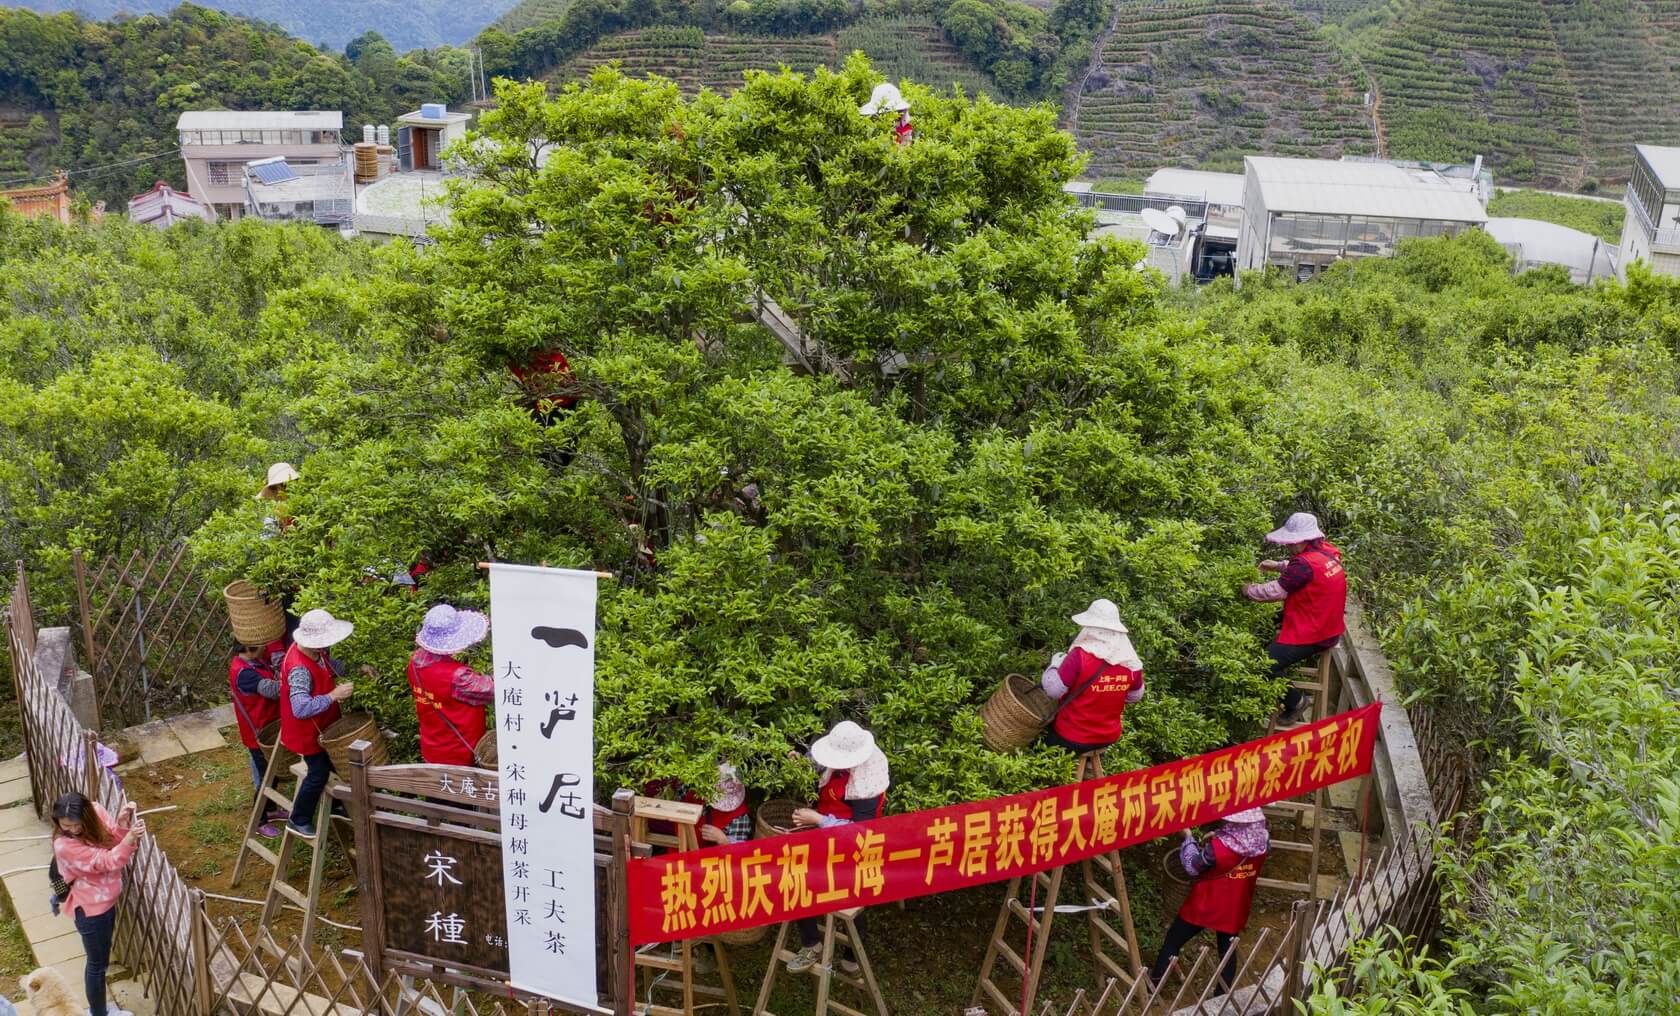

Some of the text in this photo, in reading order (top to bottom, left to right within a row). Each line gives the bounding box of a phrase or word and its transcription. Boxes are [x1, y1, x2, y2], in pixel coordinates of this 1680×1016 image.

[660, 716, 1364, 934] 热烈庆祝上海一芦居获得大庵村宋种母树茶开采权
[423, 849, 469, 945] 宋種
[541, 867, 567, 956] 工夫茶
